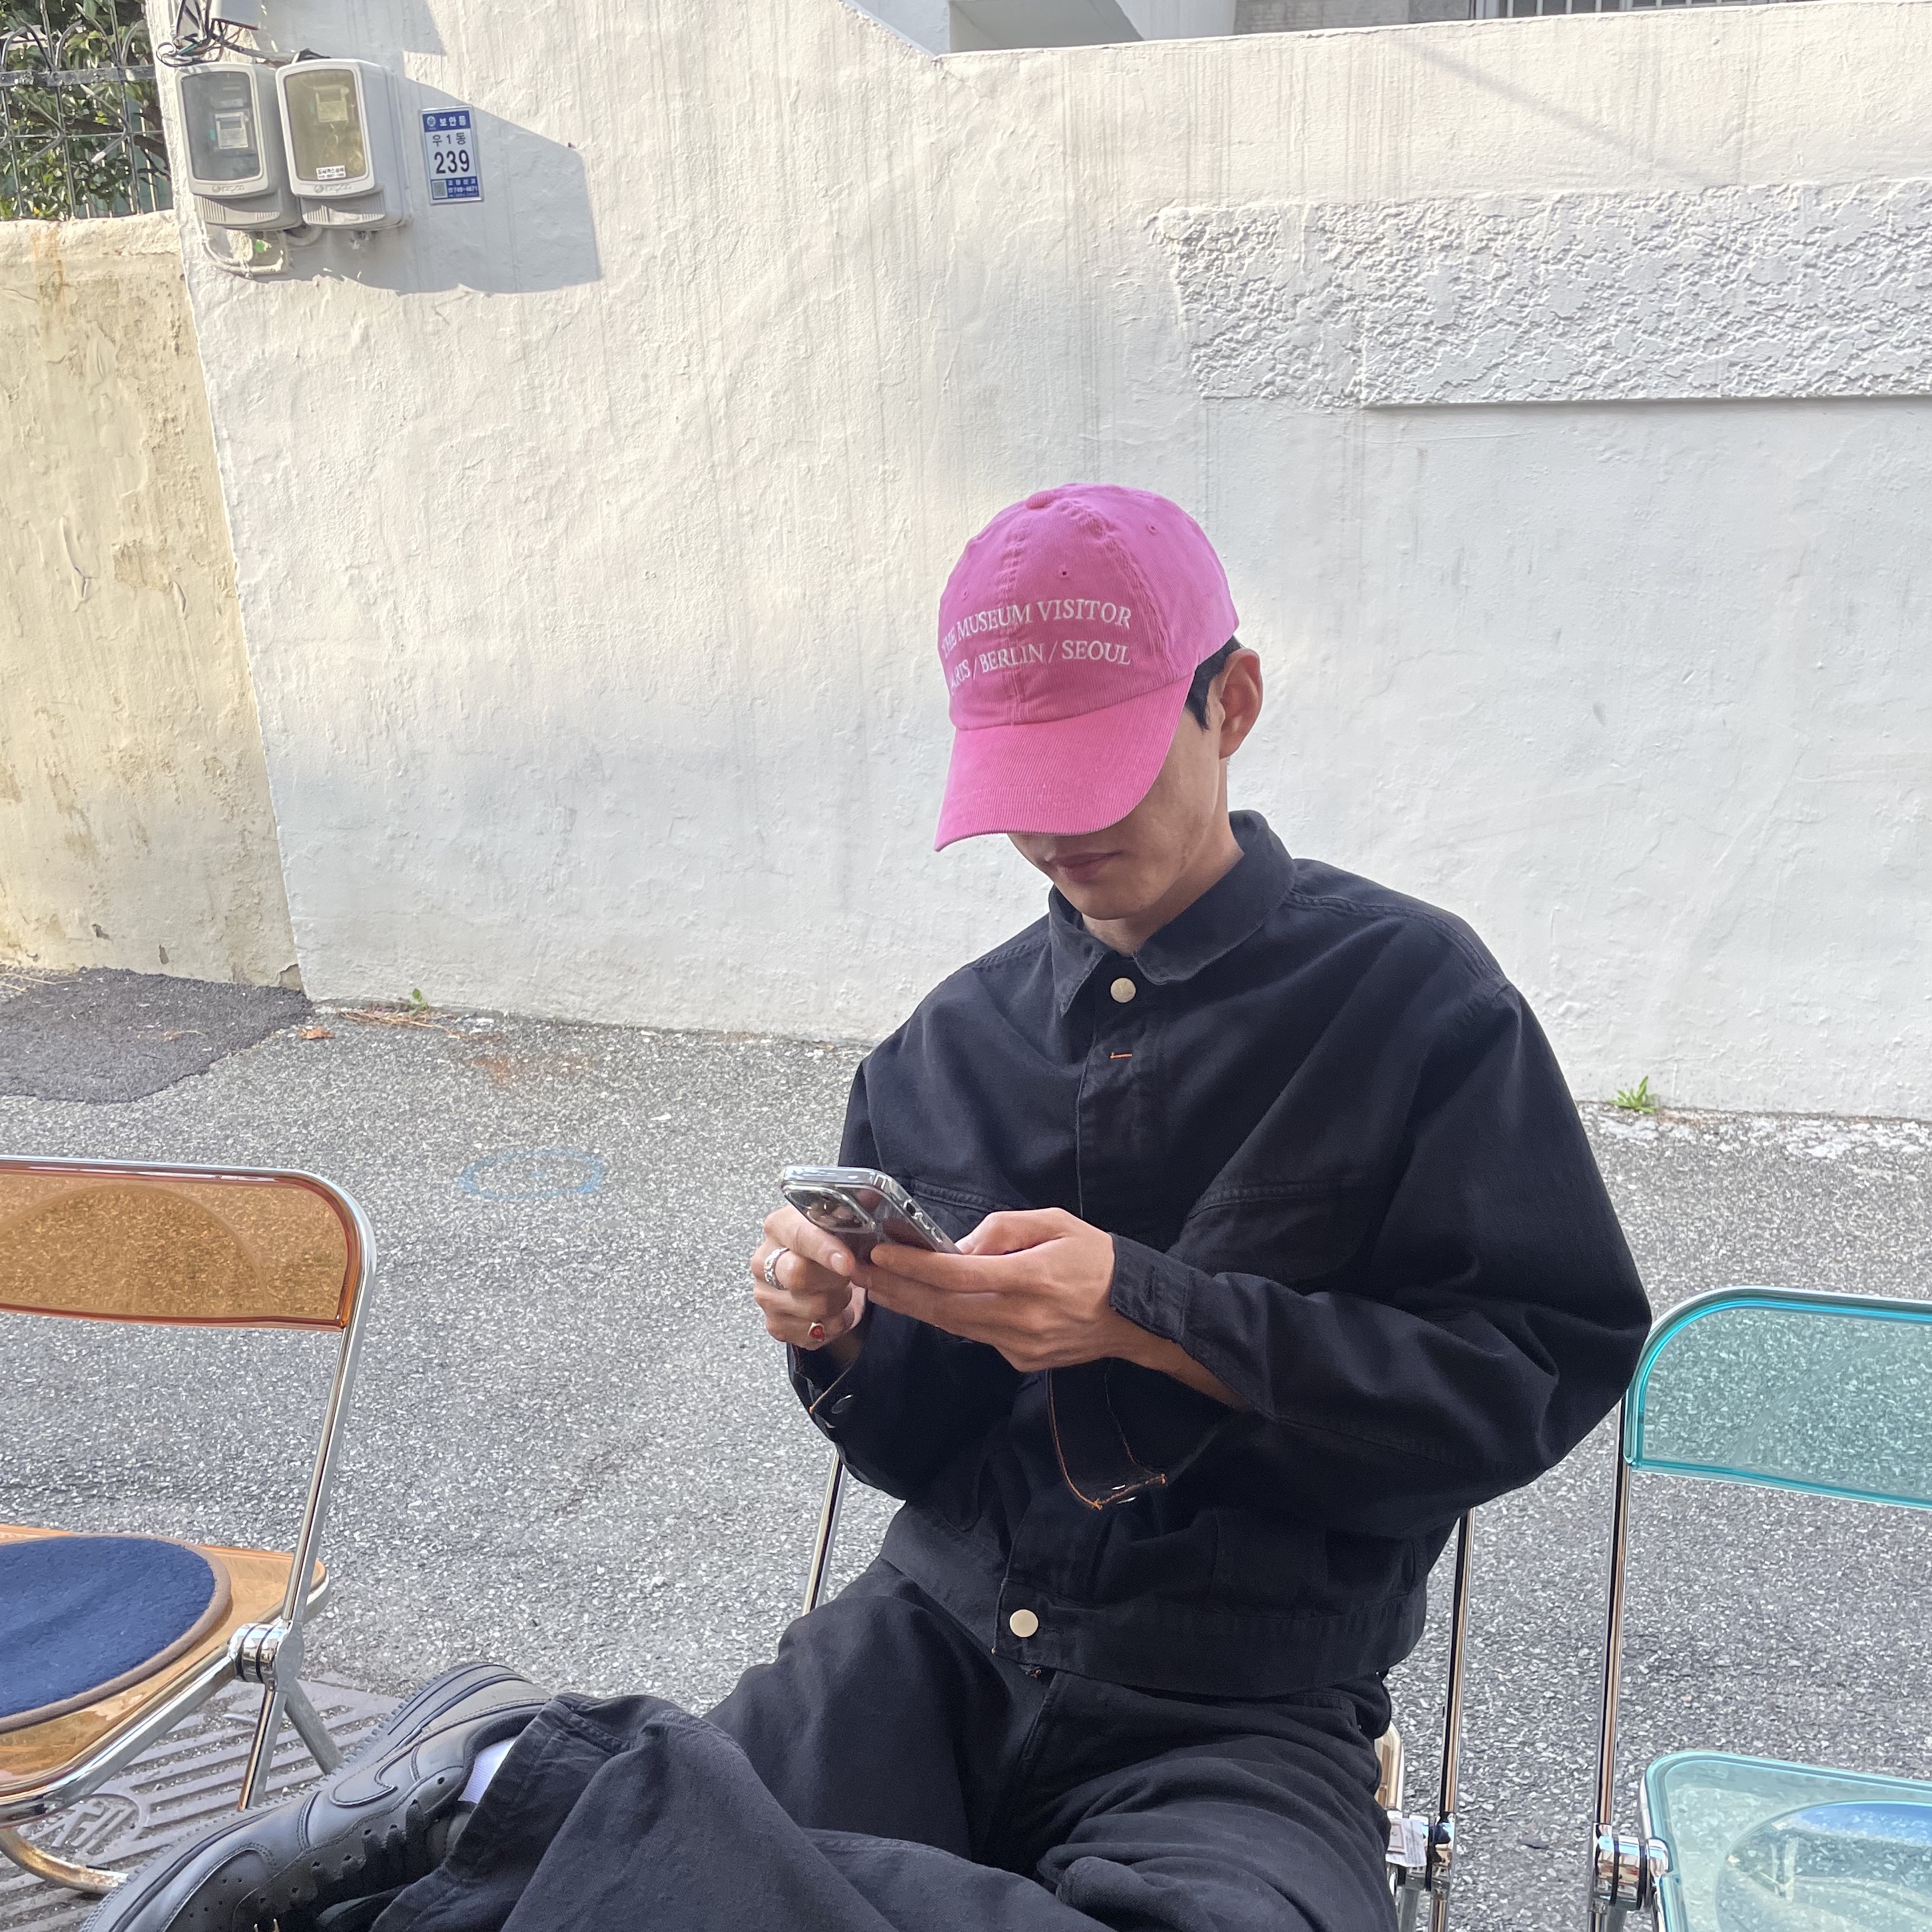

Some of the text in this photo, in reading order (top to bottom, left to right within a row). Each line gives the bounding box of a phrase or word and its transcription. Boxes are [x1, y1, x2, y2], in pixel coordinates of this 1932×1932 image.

[434, 149, 470, 174] 239
[941, 599, 1132, 659] THE MUSEUM VISITOR
[979, 643, 1044, 673] BERLIN
[1062, 640, 1132, 665] SEOUL
